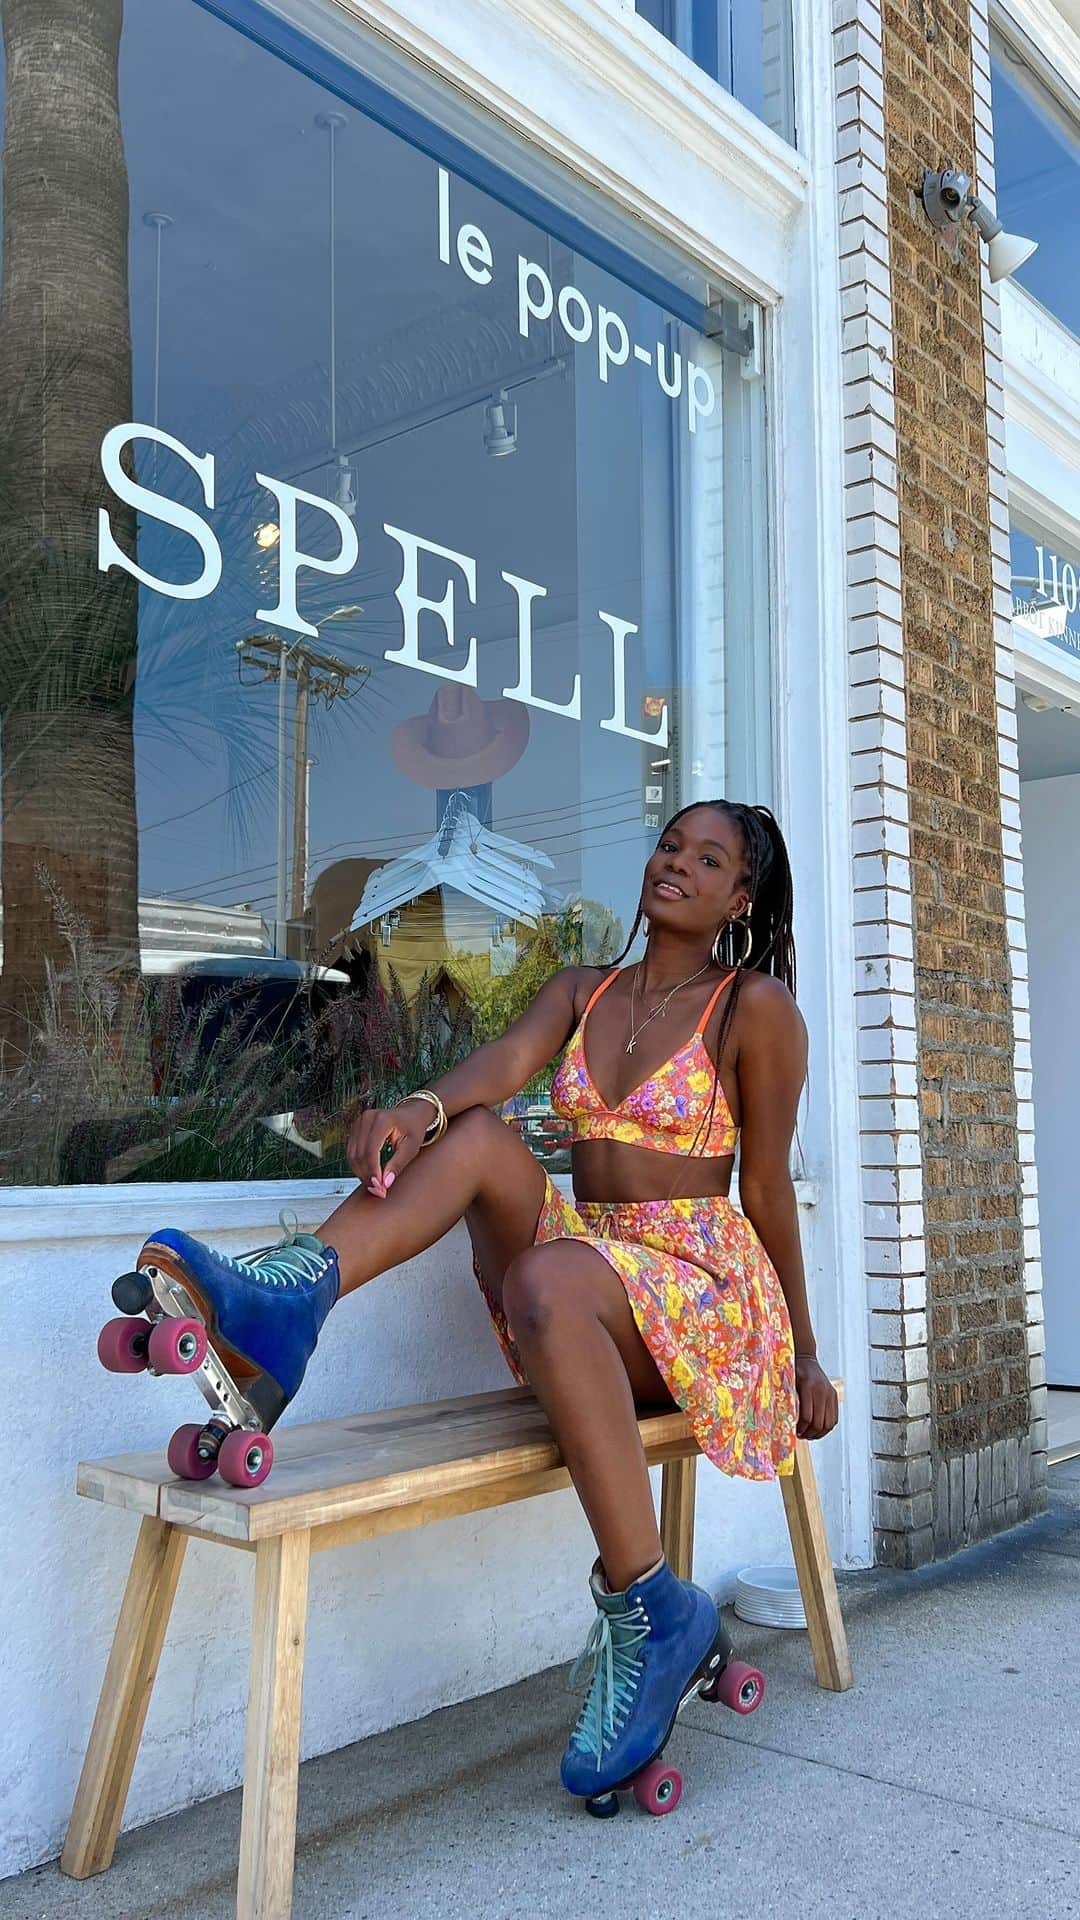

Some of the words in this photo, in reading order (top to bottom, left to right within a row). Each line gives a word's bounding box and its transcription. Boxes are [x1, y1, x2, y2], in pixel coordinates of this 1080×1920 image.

[438, 168, 493, 286] le
[517, 254, 715, 433] pop-up
[97, 422, 668, 747] SPELL
[1035, 546, 1080, 613] 110
